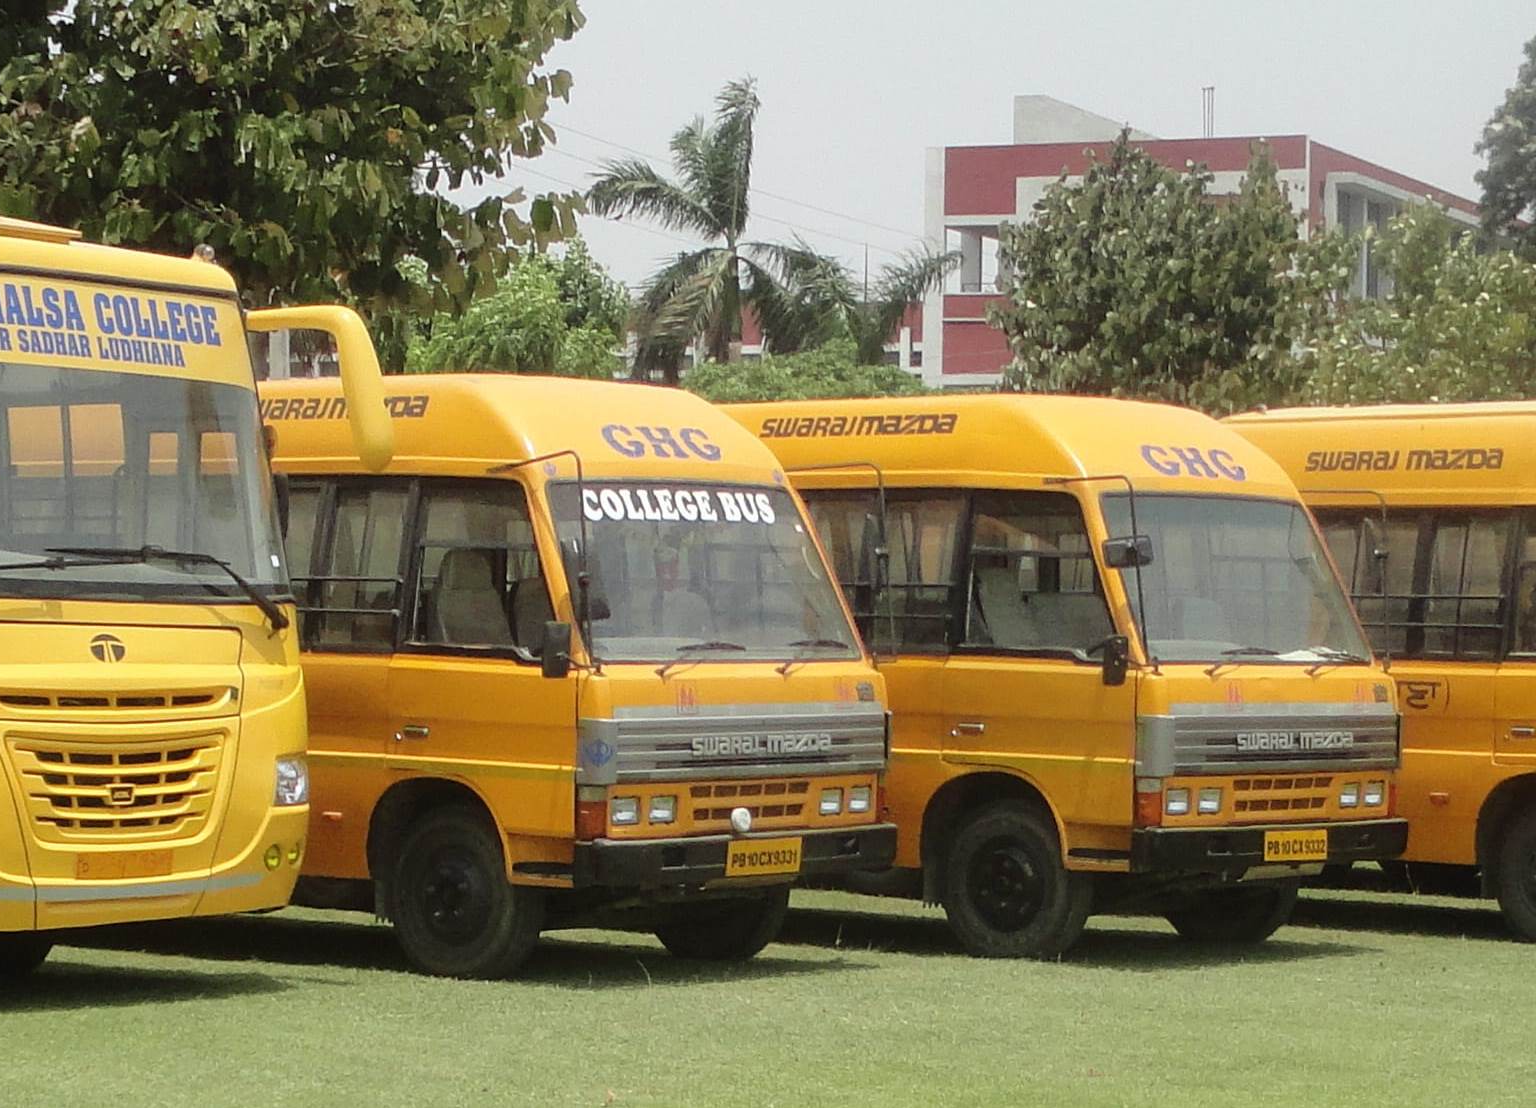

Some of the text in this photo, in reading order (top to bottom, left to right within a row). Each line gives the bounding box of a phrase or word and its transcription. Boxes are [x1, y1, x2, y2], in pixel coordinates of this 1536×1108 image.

[94, 293, 221, 346] COLLEGE
[18, 330, 91, 358] SADHAR
[97, 336, 186, 367] LUDHIANA
[601, 424, 722, 461] GHG
[1141, 444, 1246, 481] GHG
[581, 488, 776, 525] COLLEGE BUS
